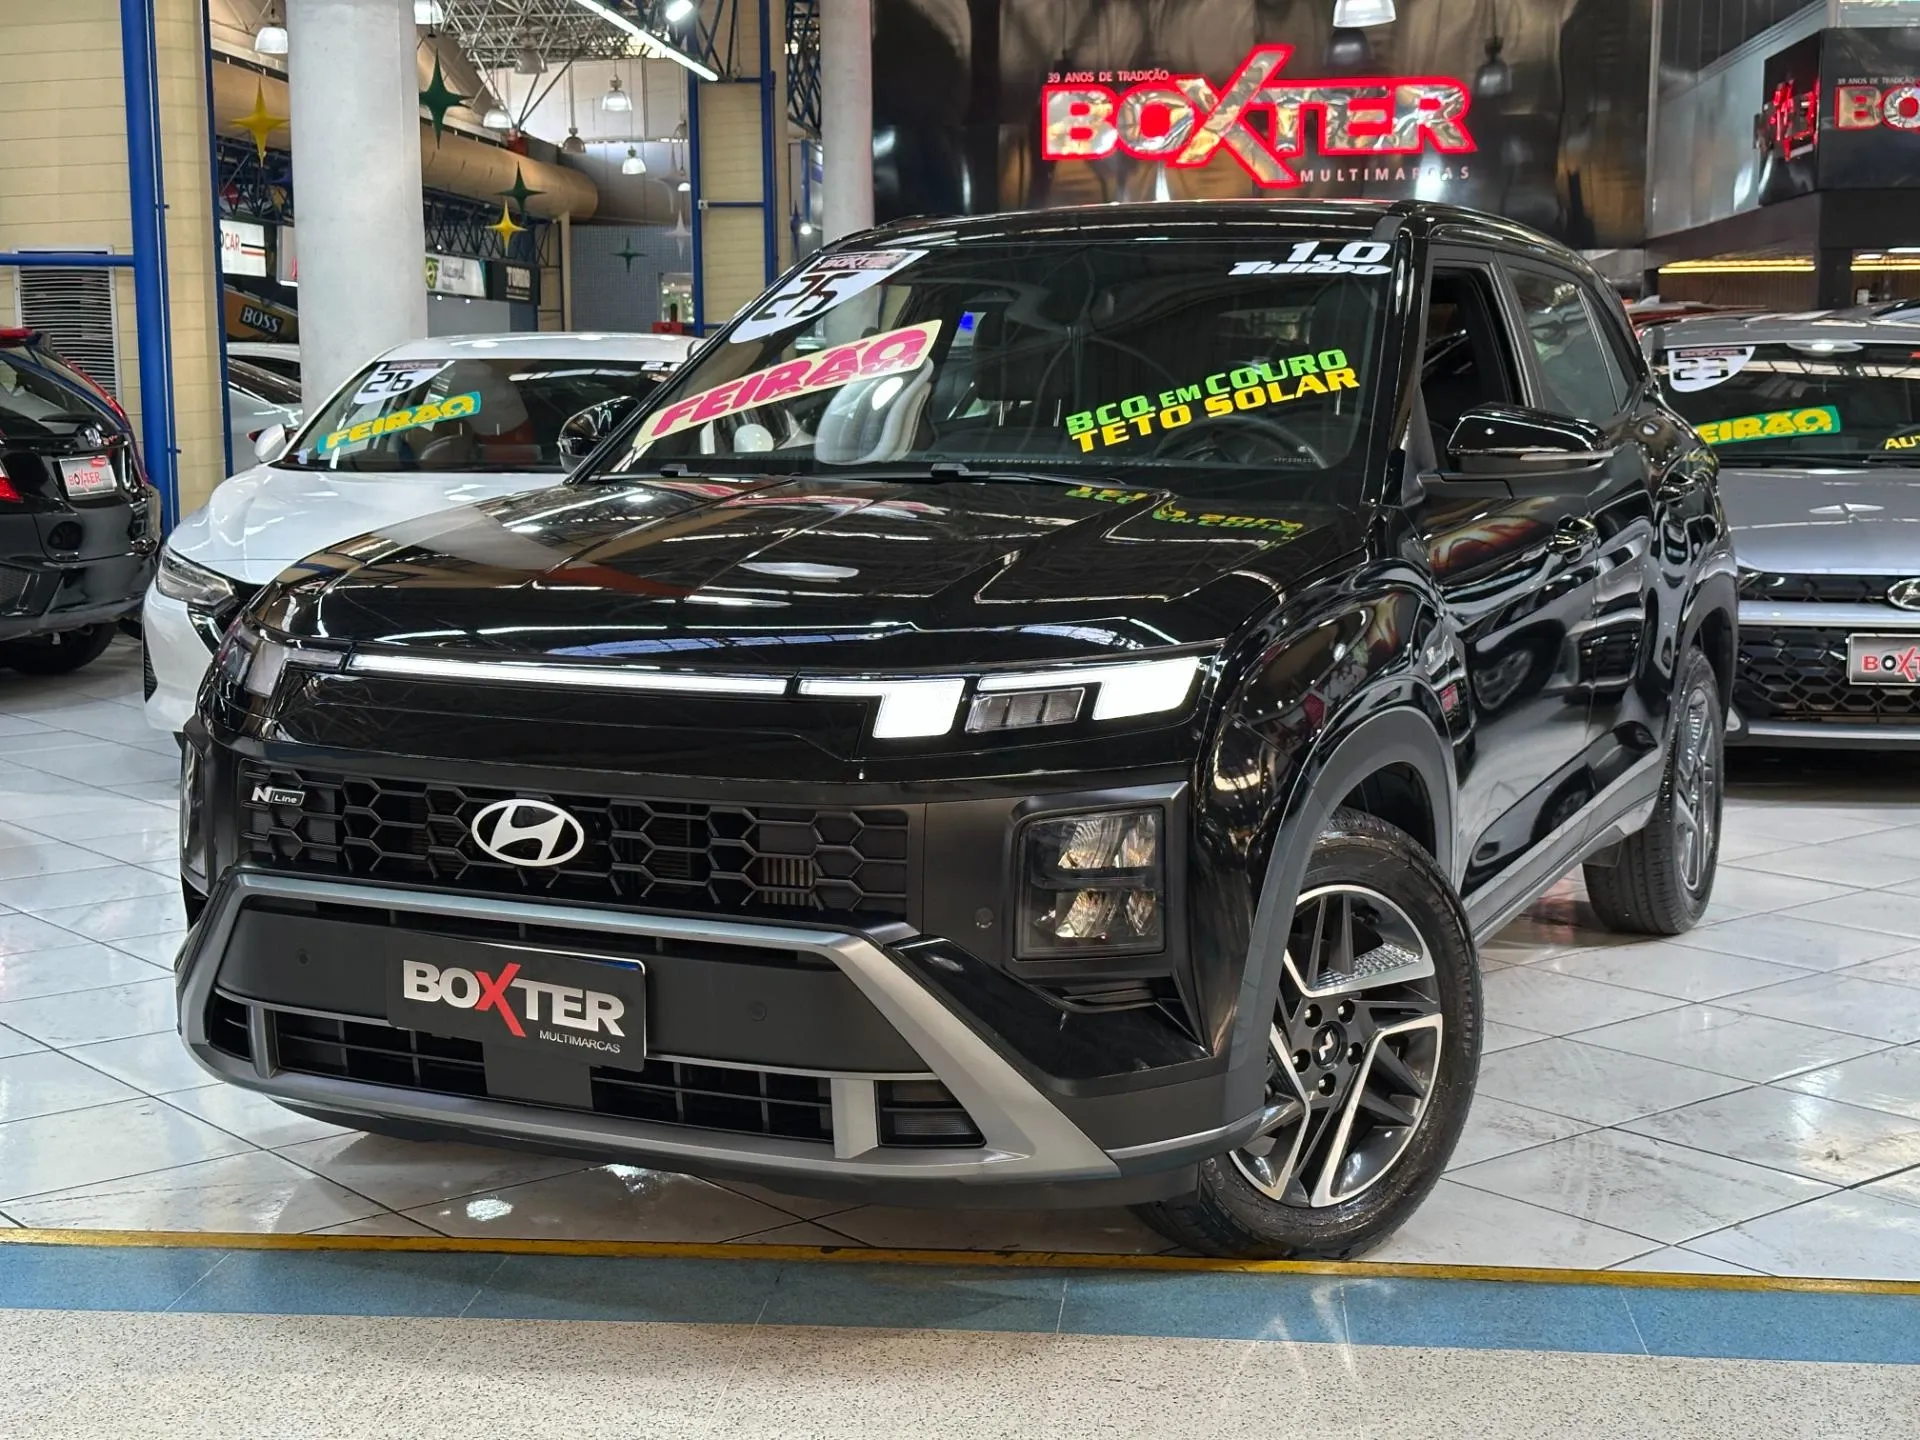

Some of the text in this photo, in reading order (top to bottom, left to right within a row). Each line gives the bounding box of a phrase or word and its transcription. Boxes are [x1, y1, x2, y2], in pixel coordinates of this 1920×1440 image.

[1047, 68, 1169, 83] 39 ANOS DE TRADIÇÃO
[1042, 44, 1477, 189] BOXTER
[1834, 78, 1920, 132] BO
[1287, 241, 1391, 263] 1.0
[241, 307, 278, 333] BOSS
[751, 271, 861, 322] 25
[650, 328, 928, 437] FEIRÃO
[1159, 384, 1202, 408] EM
[1205, 349, 1348, 395] COURO
[1072, 358, 1360, 453] TETO SOLAR
[1696, 408, 1833, 444] EIRÃO
[251, 786, 298, 804] N Line
[403, 959, 626, 1038] BOXTER
[539, 1030, 622, 1054] MULTIMARCAS
